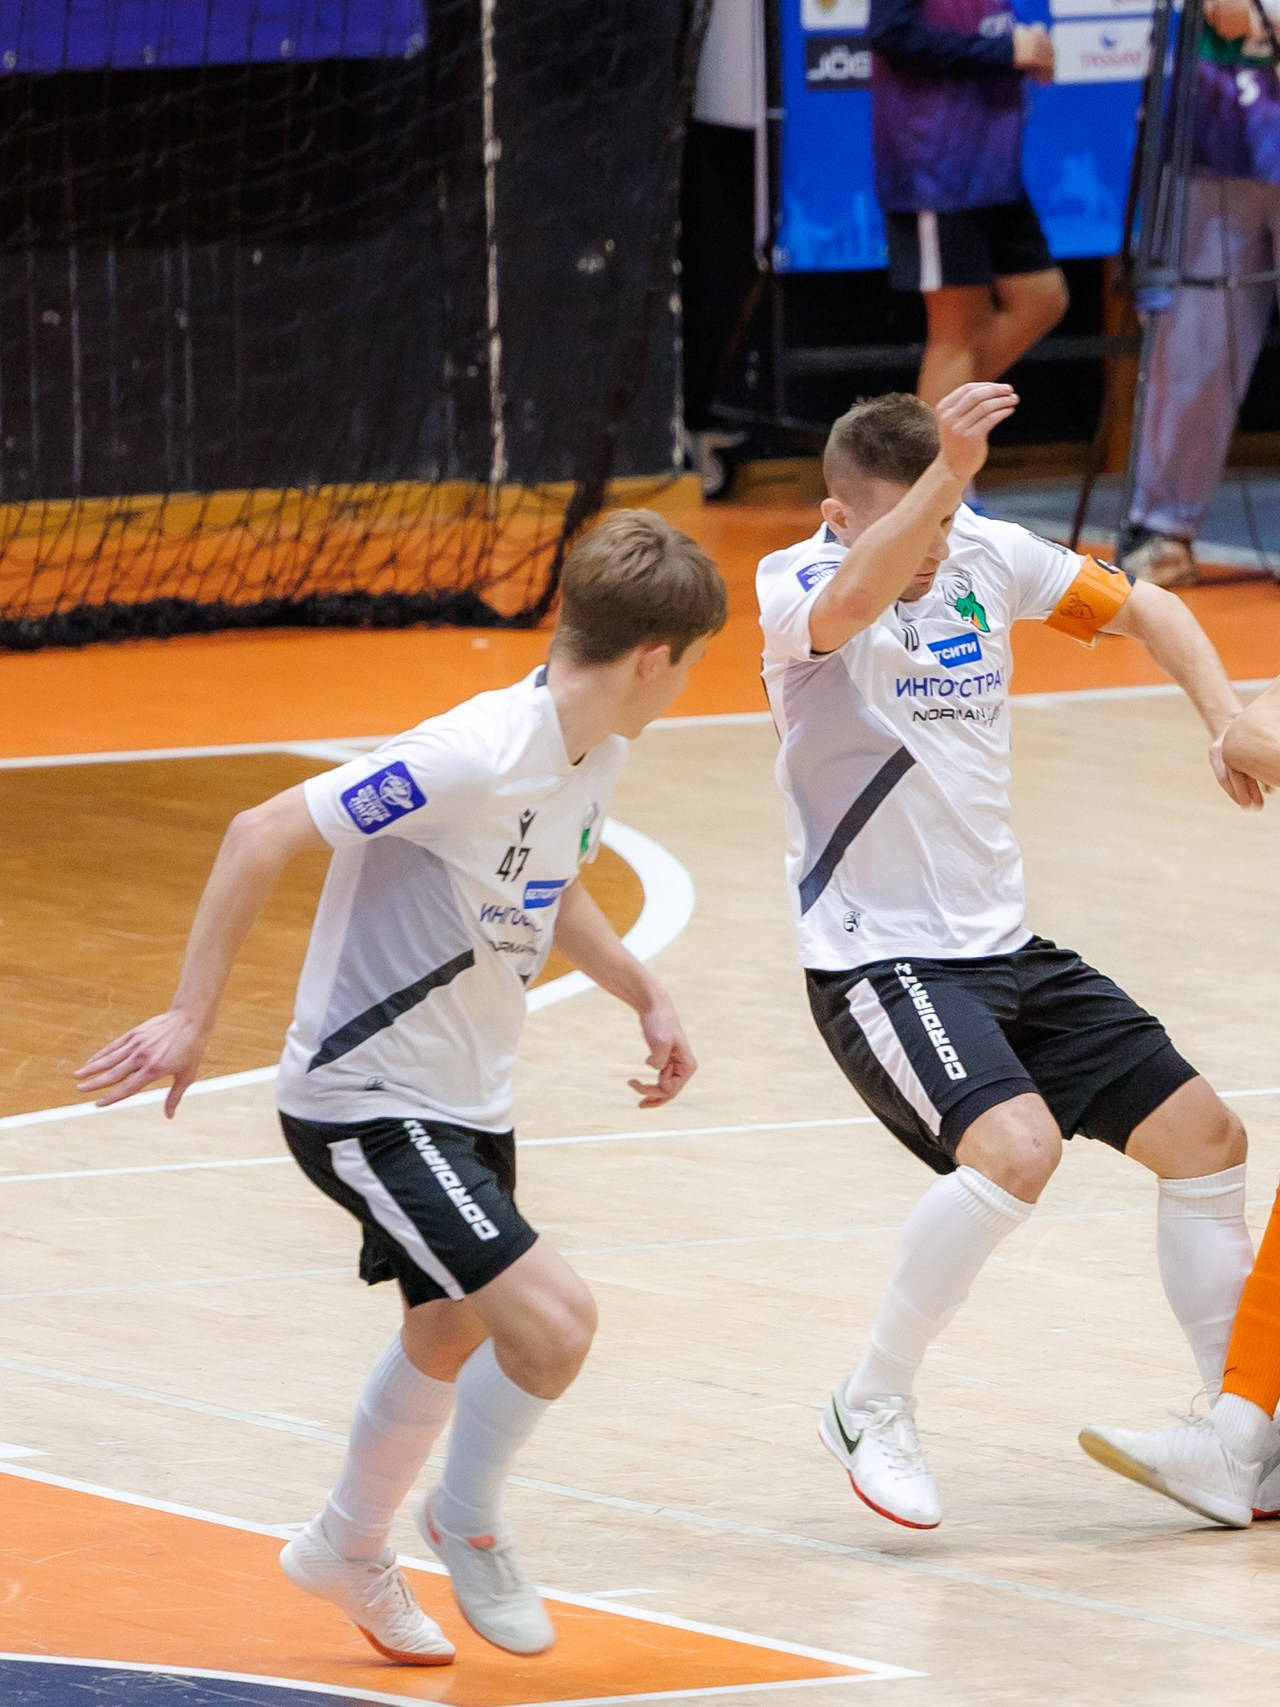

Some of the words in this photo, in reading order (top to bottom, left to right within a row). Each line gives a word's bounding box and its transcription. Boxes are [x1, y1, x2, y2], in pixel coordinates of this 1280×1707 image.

[896, 667, 1004, 699] ИНГОСТРА
[496, 846, 533, 882] 47
[898, 976, 968, 1081] CORDIANT
[408, 1127, 500, 1241] CORDIANT
